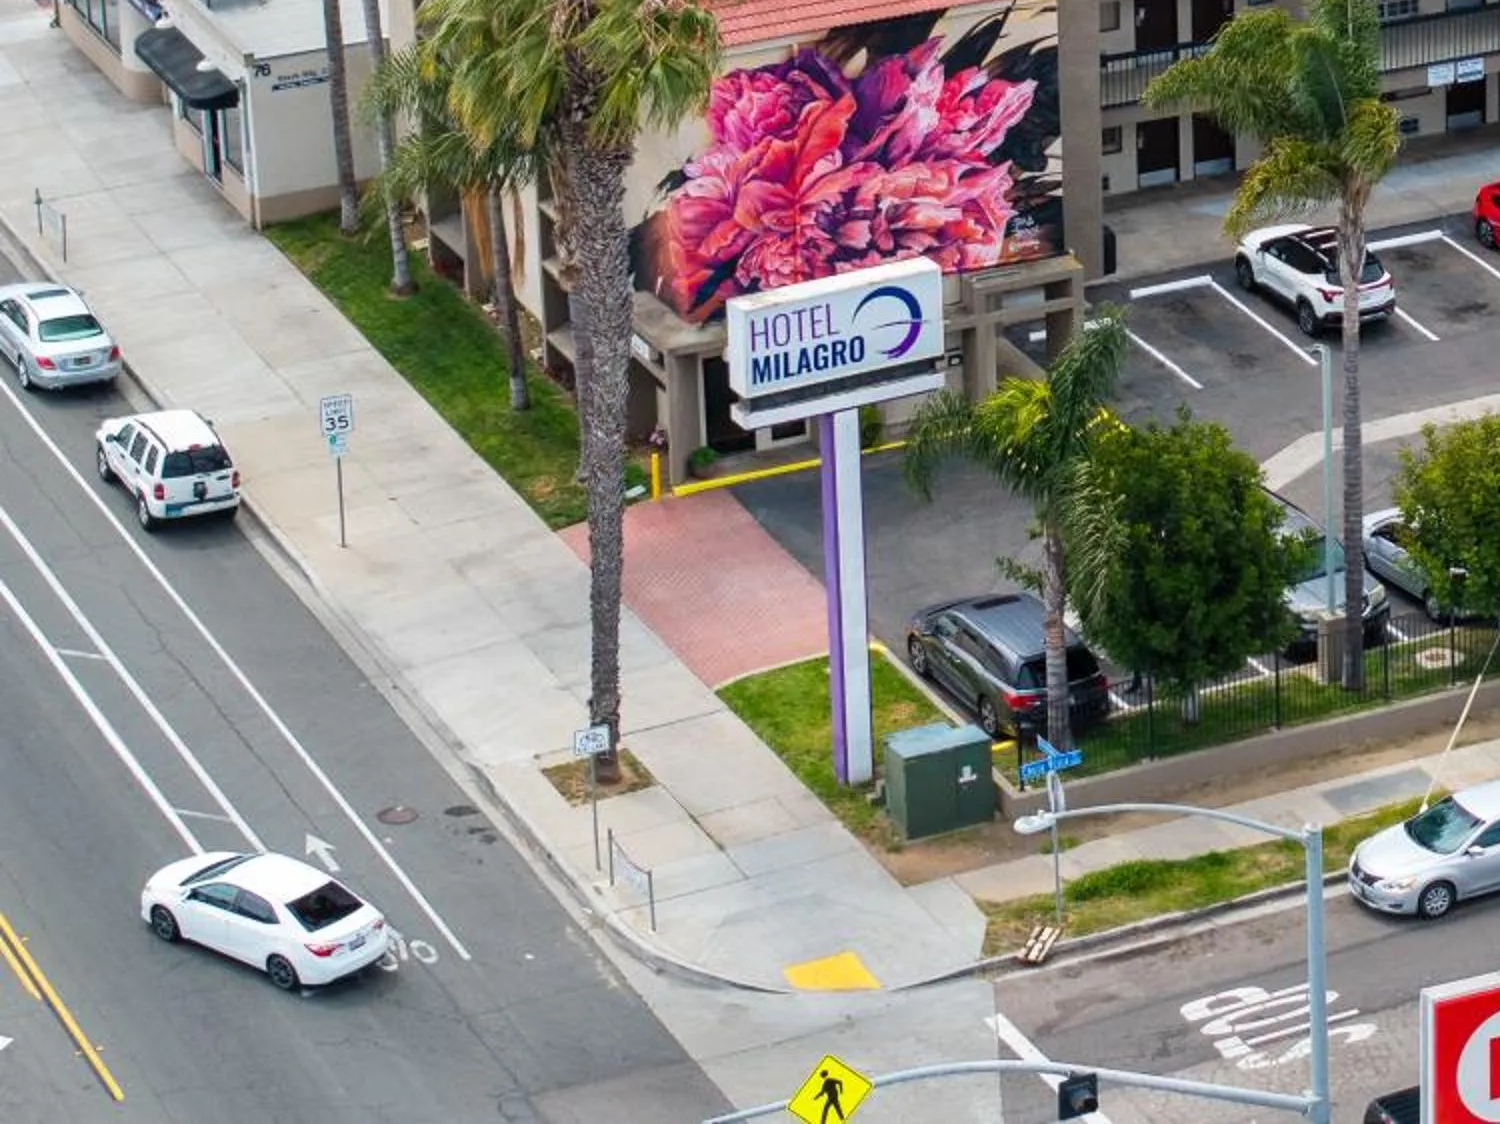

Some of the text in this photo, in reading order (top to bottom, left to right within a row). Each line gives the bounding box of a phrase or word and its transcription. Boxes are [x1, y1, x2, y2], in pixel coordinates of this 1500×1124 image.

[751, 303, 839, 351] HOTEL
[752, 335, 865, 385] MILAGRO
[325, 415, 349, 431] 35
